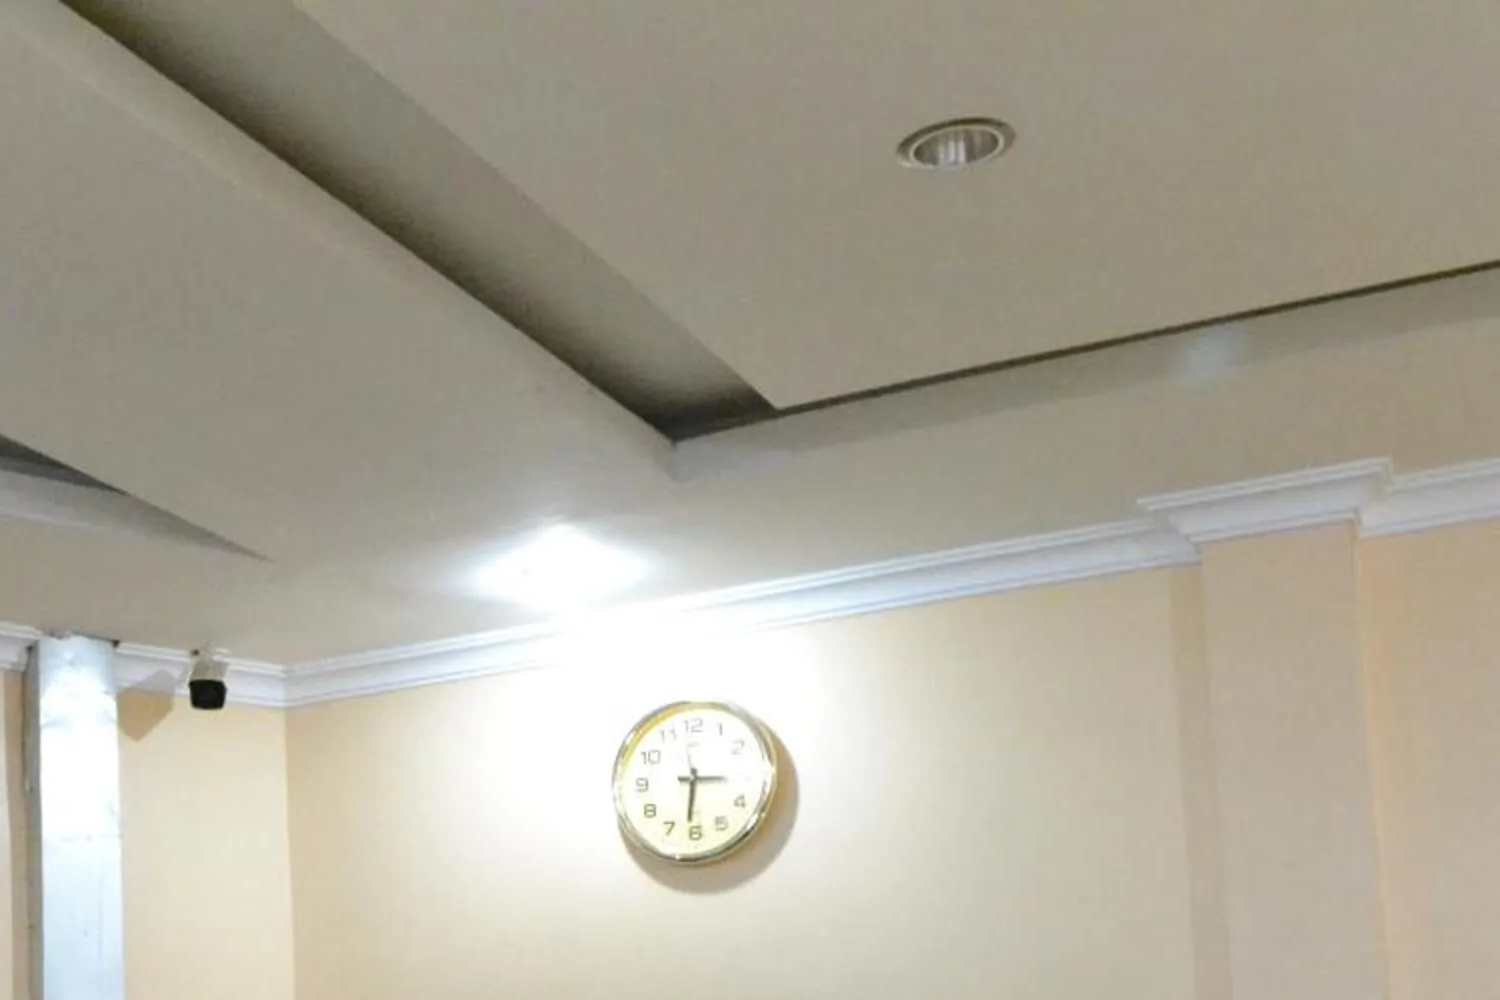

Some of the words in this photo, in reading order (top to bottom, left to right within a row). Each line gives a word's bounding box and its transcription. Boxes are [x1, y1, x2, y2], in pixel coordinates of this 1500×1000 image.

[683, 717, 704, 733] 12
[658, 726, 678, 742] 11
[731, 738, 746, 755] 2
[640, 749, 661, 766] 10
[635, 777, 649, 792] 9
[733, 794, 746, 808] 4
[643, 803, 657, 818] 8
[663, 821, 675, 836] 7
[715, 815, 729, 831] 5
[689, 825, 702, 841] 6
